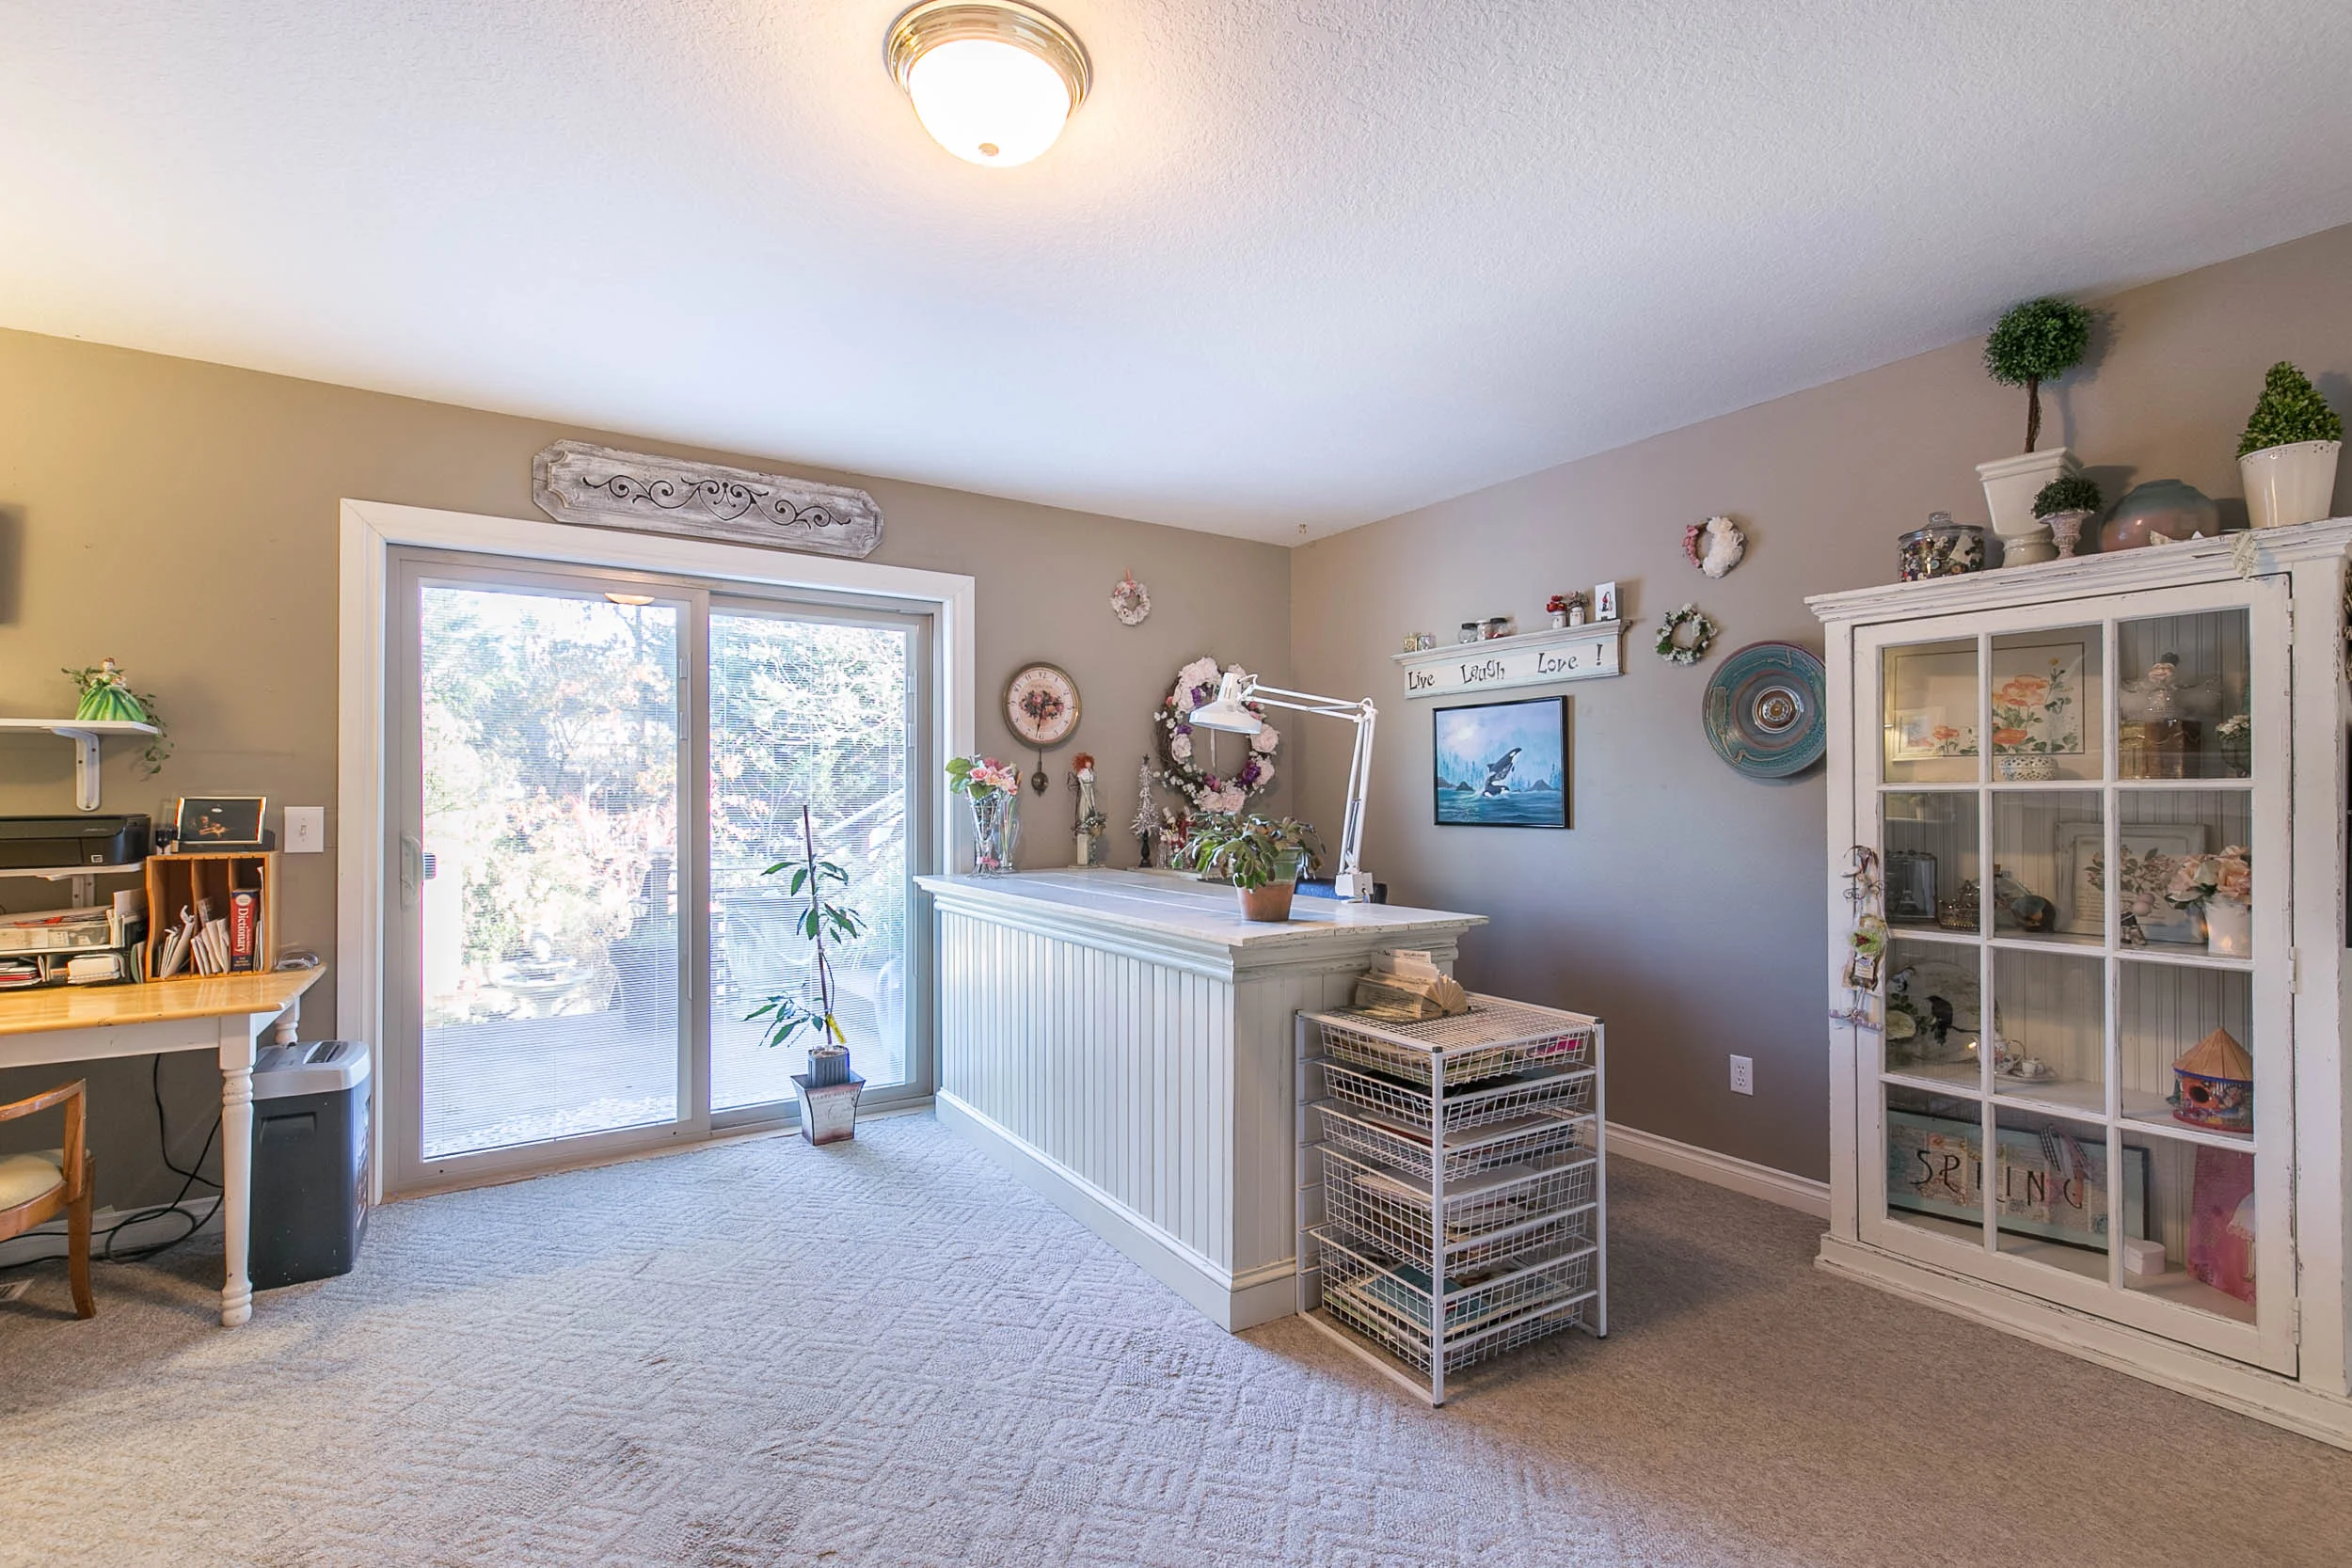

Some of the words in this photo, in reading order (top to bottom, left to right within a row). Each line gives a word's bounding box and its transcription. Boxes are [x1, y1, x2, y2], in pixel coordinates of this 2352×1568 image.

[1408, 671, 1436, 690] Live
[1460, 659, 1505, 685] Laugh
[1537, 652, 1579, 674] Love
[1596, 643, 1603, 666] !
[233, 908, 249, 953] Dictionary
